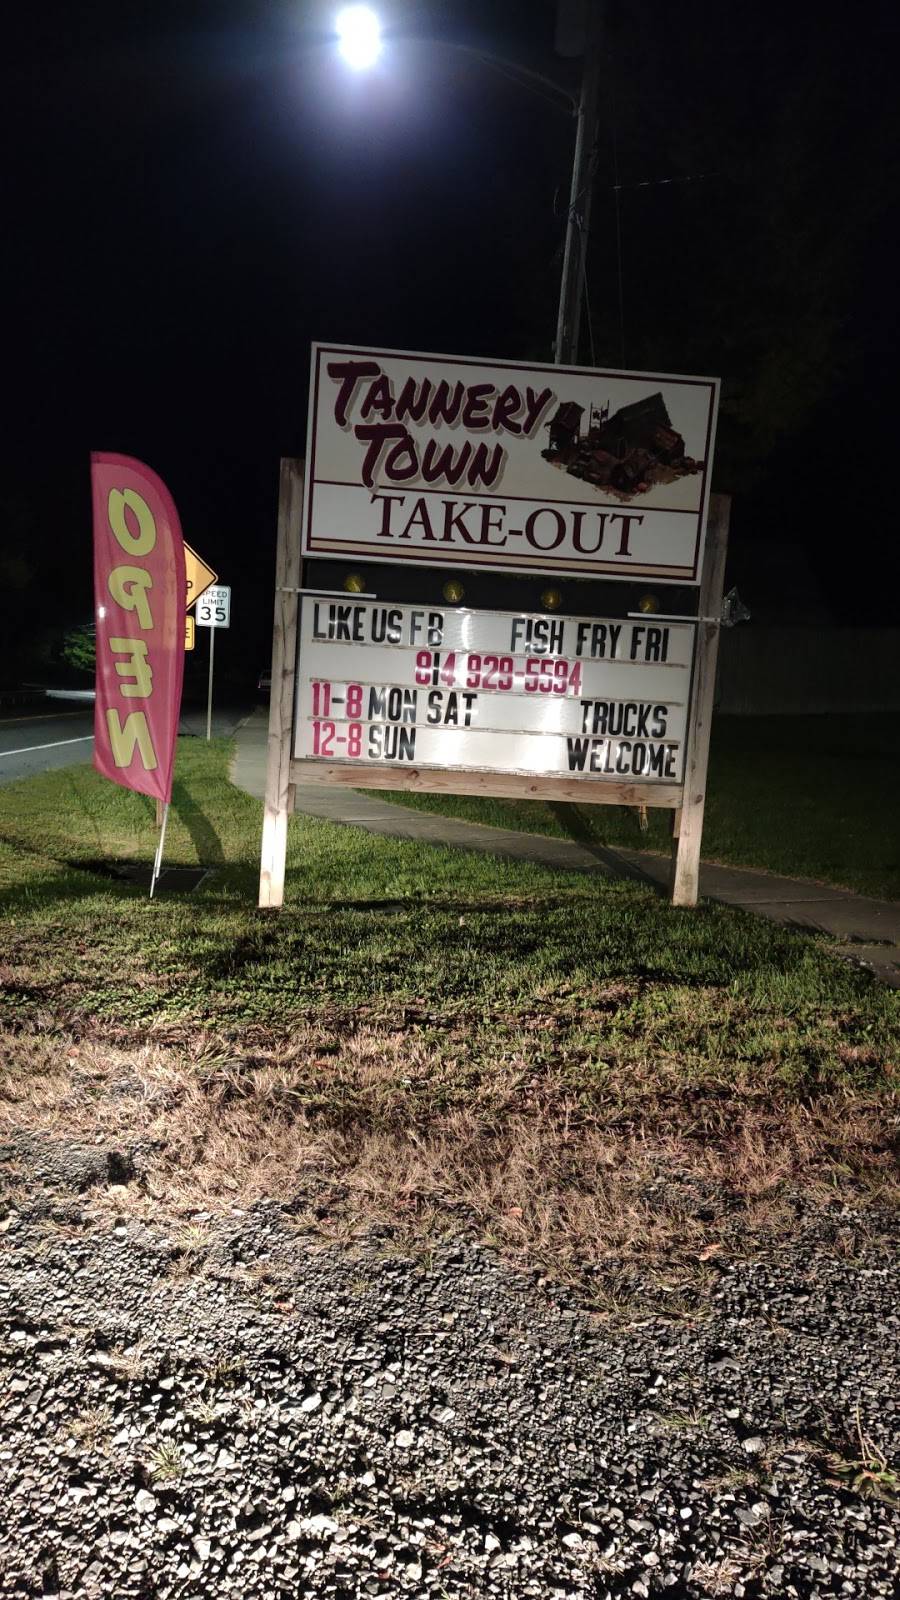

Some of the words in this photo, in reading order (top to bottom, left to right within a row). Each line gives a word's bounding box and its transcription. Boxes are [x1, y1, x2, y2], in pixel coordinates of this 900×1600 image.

[326, 360, 558, 440] TANNERY
[353, 422, 508, 492] TOWN
[370, 493, 645, 557] TAKE-OUT
[200, 606, 226, 622] 35
[313, 603, 366, 641] LIKE
[371, 608, 403, 644] US
[511, 618, 565, 654] FISH
[575, 622, 622, 659] FRY
[630, 626, 670, 662] FRI
[415, 650, 457, 687] 814
[466, 654, 582, 695] 929-5594
[312, 682, 363, 719] 11-8
[368, 686, 418, 723] MON
[427, 690, 478, 726] SAT
[580, 700, 668, 738] TRUCKS
[312, 721, 363, 758] 12-8
[368, 724, 417, 761] SUN
[567, 738, 679, 777] WELCOME
